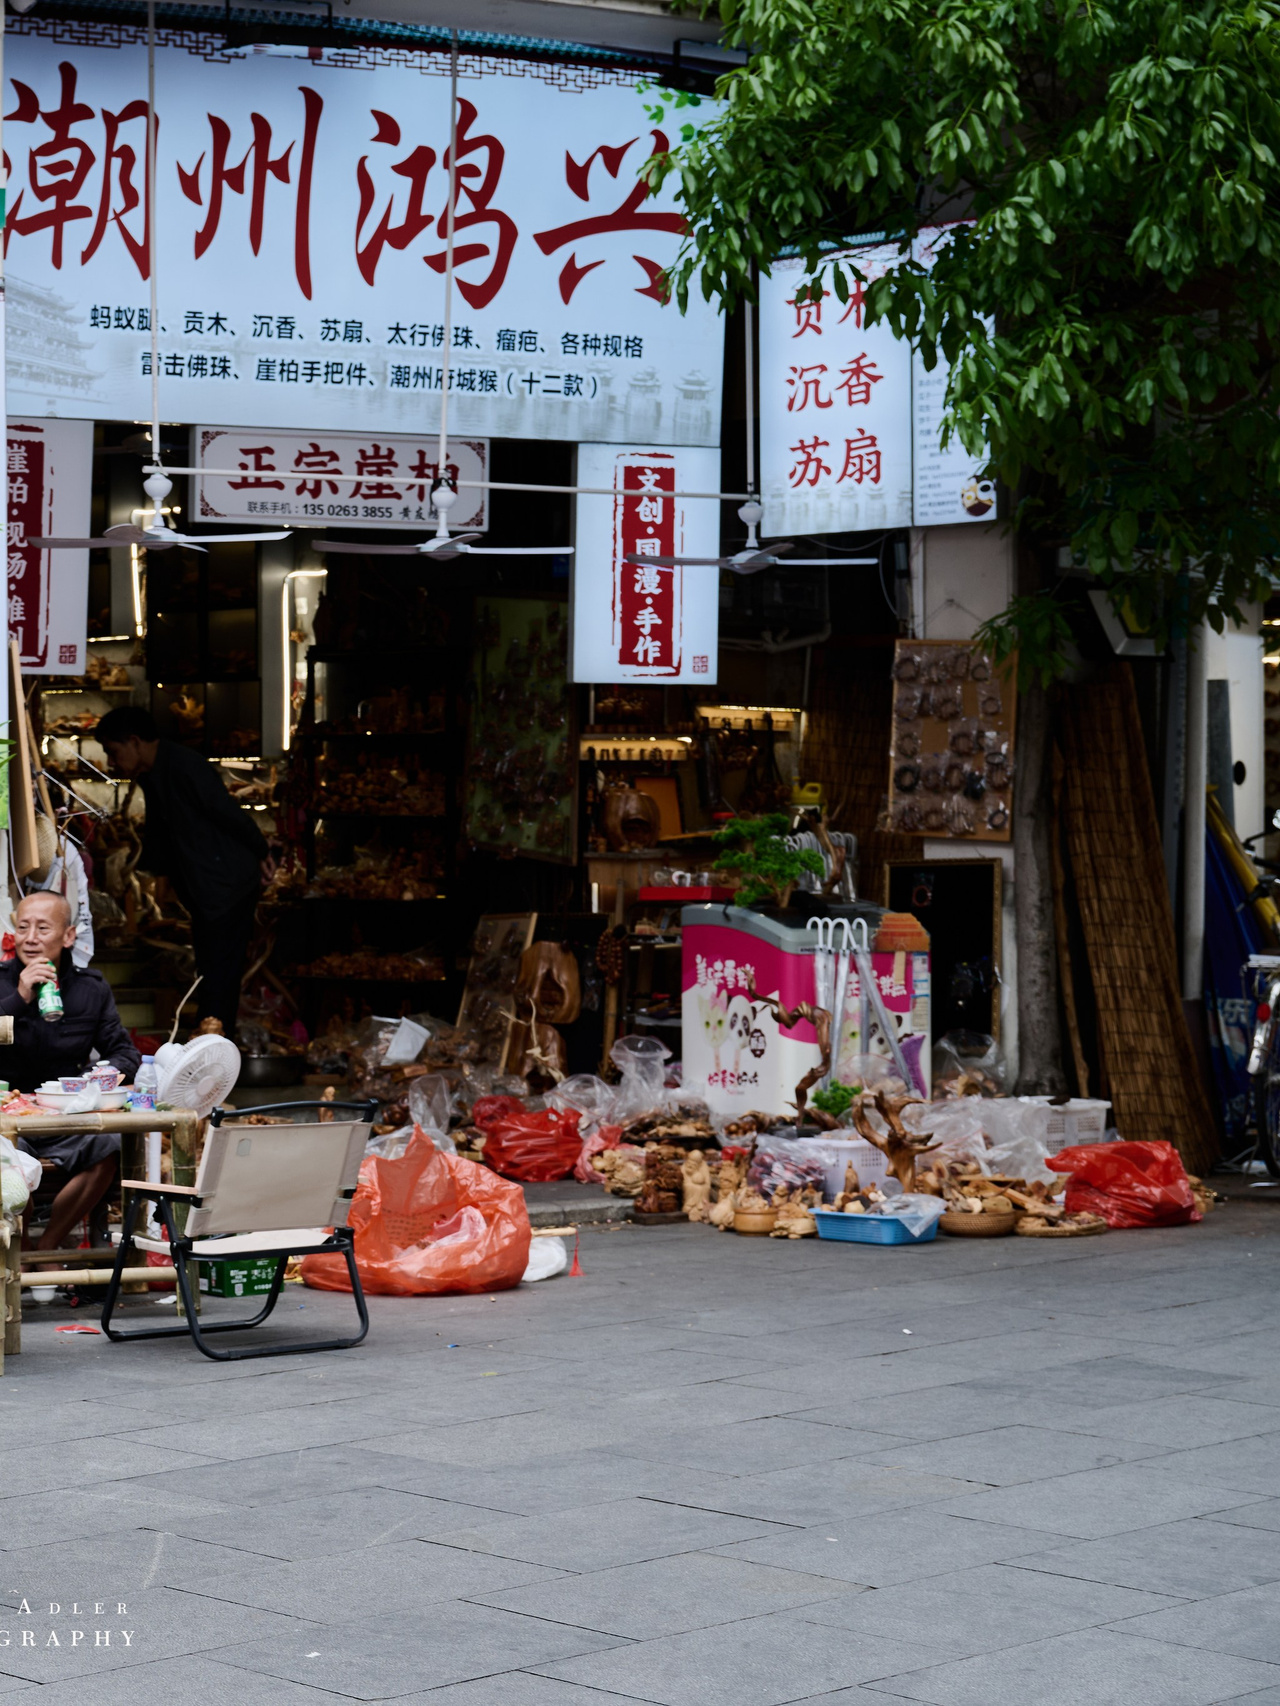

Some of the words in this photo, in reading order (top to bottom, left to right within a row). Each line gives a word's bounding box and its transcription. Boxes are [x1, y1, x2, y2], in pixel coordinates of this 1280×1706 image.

[4, 61, 695, 311] 潮州鸿兴
[785, 351, 885, 413] 沉香
[227, 442, 460, 503] 正宗崖柏
[788, 427, 883, 489] 苏扇
[328, 504, 359, 518] 0263
[361, 505, 393, 519] 3855
